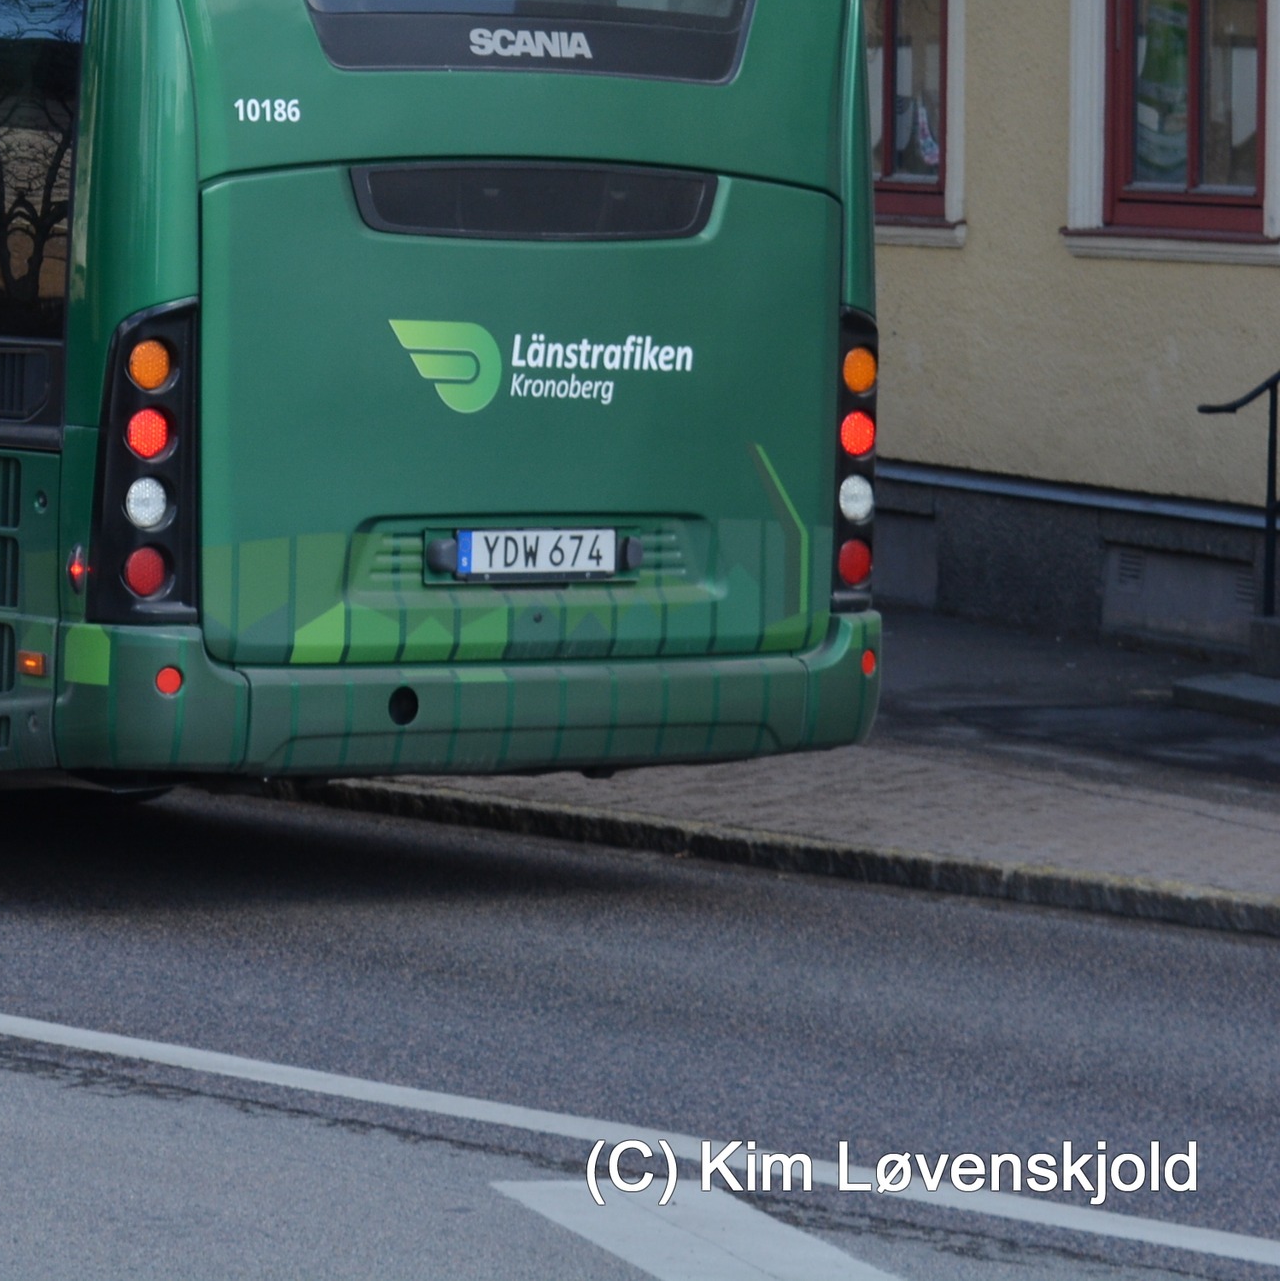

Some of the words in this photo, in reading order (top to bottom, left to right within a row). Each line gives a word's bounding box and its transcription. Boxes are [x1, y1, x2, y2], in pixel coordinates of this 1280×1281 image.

[469, 28, 593, 59] SCANIA
[233, 98, 300, 122] 10186
[511, 333, 693, 371] Länstrafiken
[510, 373, 614, 405] Kronoberg
[461, 557, 468, 567] S
[484, 535, 540, 568] YDW
[549, 534, 603, 567] 674
